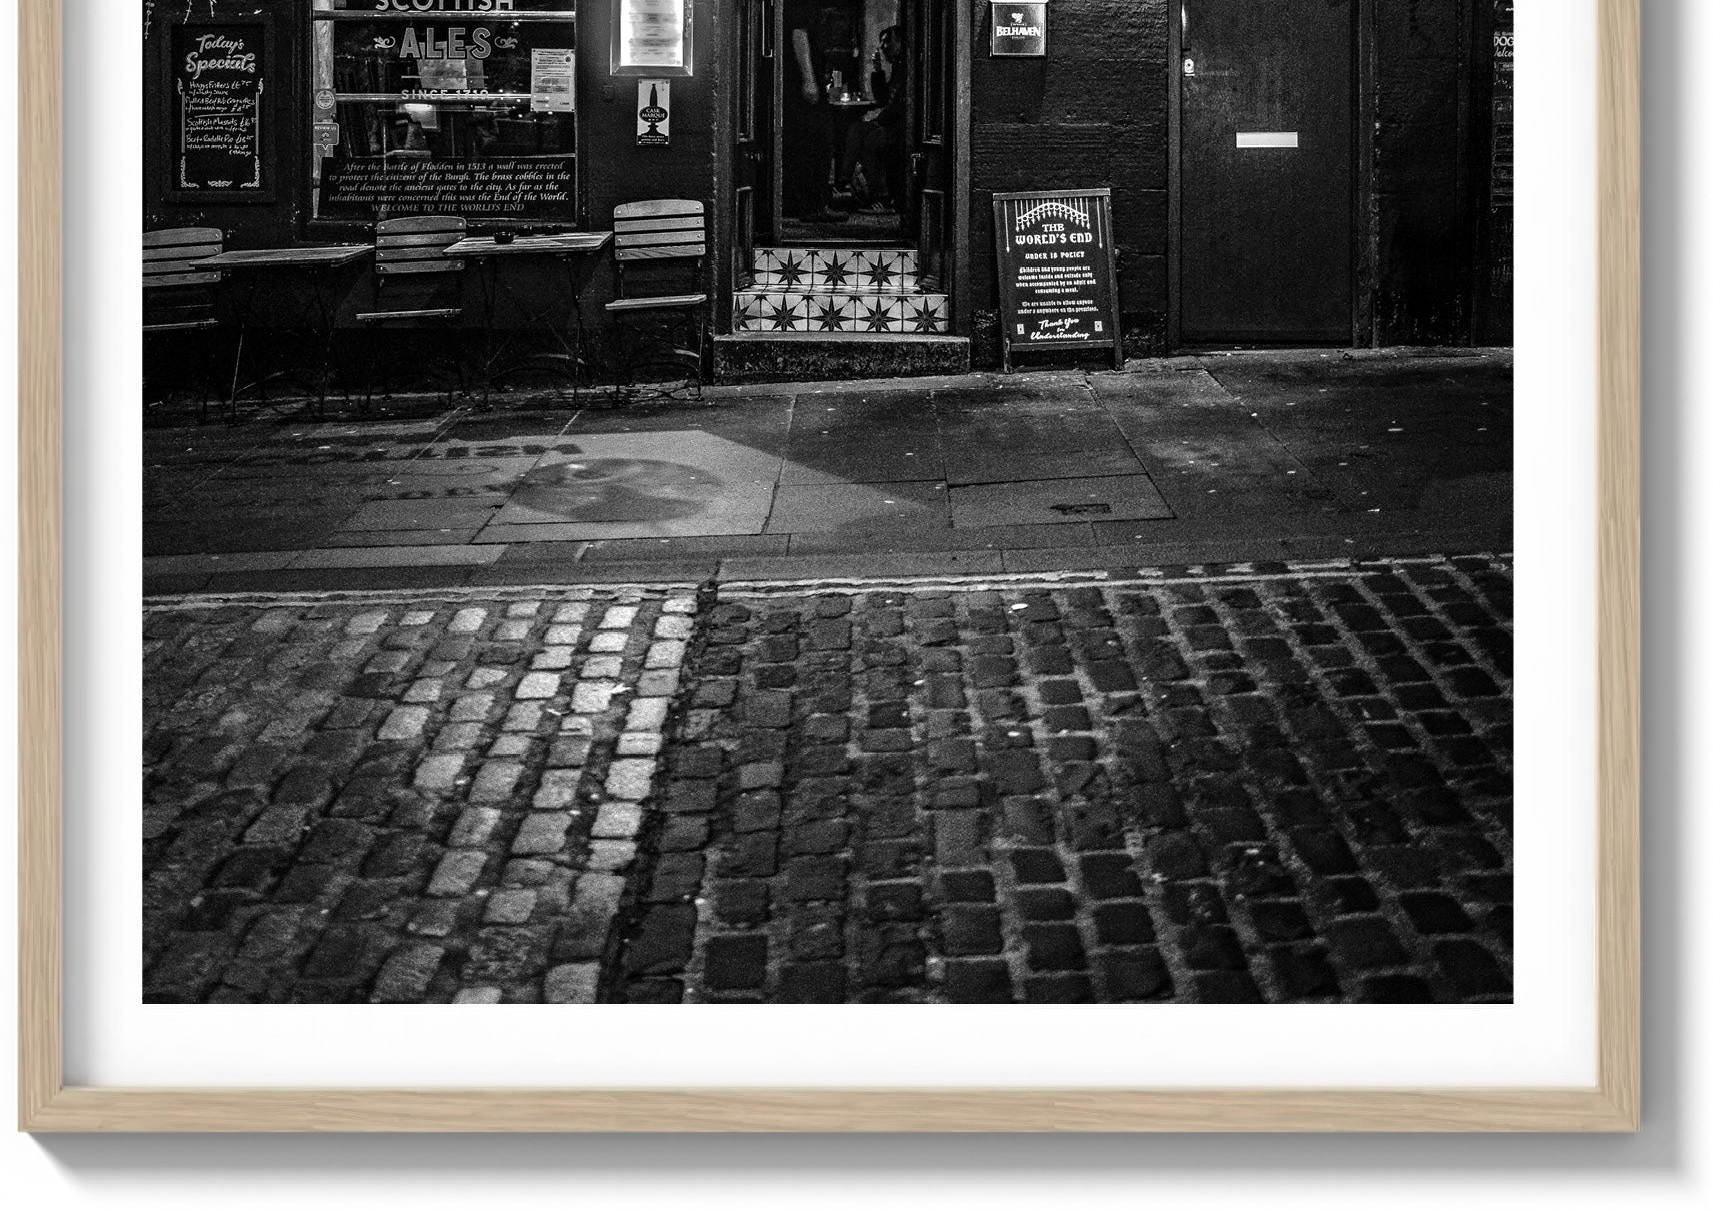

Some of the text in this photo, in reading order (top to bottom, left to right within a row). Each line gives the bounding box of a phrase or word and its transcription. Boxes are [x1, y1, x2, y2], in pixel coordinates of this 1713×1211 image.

[996, 26, 1041, 37] BELHAVEN
[195, 33, 245, 54] Today's
[399, 27, 492, 59] ALES
[185, 51, 256, 80] Specials
[401, 89, 448, 100] SINCE
[343, 162, 365, 174] After
[367, 162, 380, 170] the
[384, 162, 408, 170] Battle
[410, 162, 420, 174] of
[421, 161, 453, 170] Flodden
[456, 162, 465, 170] in
[467, 162, 486, 170] 1513
[496, 160, 517, 170] wall
[535, 160, 566, 170] erected
[328, 173, 338, 181] to
[336, 174, 368, 184] protect
[370, 172, 384, 180] the
[418, 172, 429, 185] of
[429, 172, 442, 180] the
[444, 172, 470, 184] Burgh.
[474, 171, 490, 180] The
[492, 171, 513, 180] brass
[514, 171, 543, 180] cobbles
[546, 172, 555, 180] in
[556, 170, 571, 180] the
[339, 182, 360, 191] road
[360, 182, 387, 191] denote
[388, 182, 402, 191] the
[435, 184, 458, 195] gates
[470, 181, 484, 191] the
[486, 182, 502, 194] city.
[505, 182, 516, 191] As
[516, 181, 532, 194] far
[545, 181, 560, 190] the
[328, 192, 375, 202] inhabitants
[398, 192, 440, 201] concerned
[442, 192, 457, 201] this
[478, 192, 492, 200] the
[494, 192, 512, 200] End
[512, 192, 524, 205] of
[524, 192, 538, 200] the
[540, 192, 569, 201] World.
[371, 203, 525, 212] WELCOME TO THE WORLD'S END
[1042, 223, 1065, 232] THE
[1015, 232, 1093, 246] WORLD'S END
[1024, 252, 1048, 260] UNDER
[1060, 250, 1085, 258] POLICY
[1038, 317, 1080, 330] Thank You
[1030, 331, 1091, 340] Understanding
